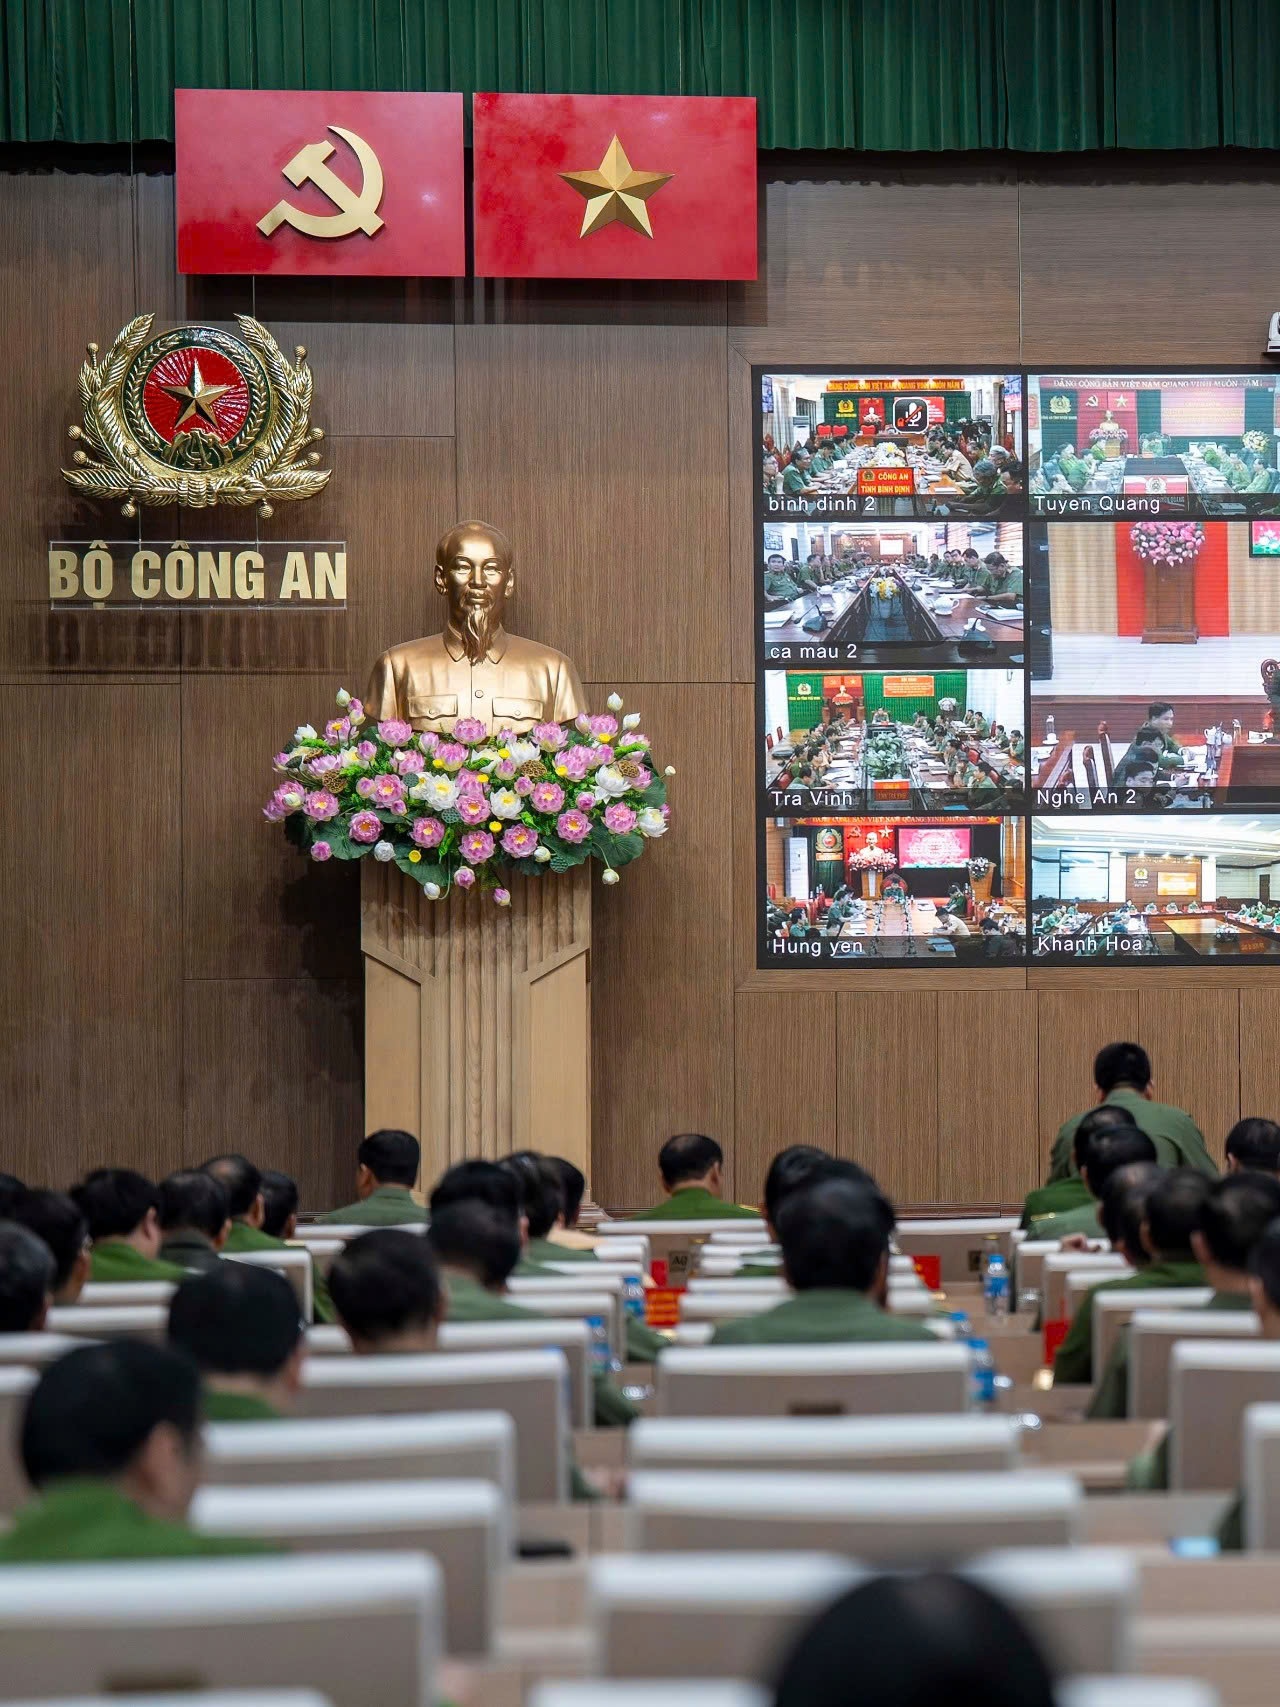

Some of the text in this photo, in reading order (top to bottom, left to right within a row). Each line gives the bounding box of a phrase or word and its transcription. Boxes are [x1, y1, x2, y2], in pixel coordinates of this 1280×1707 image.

[769, 496, 875, 511] binh dinh 2
[1034, 496, 1160, 515] Tuyen Quang
[49, 540, 347, 609] BỘ CÔNG AN
[770, 644, 857, 659] ca mau 2
[771, 791, 853, 806] Tra Vinh
[1037, 789, 1137, 807] Nghe An 2
[774, 939, 863, 957] Hung yen
[1038, 936, 1143, 951] Khanh Hoa
